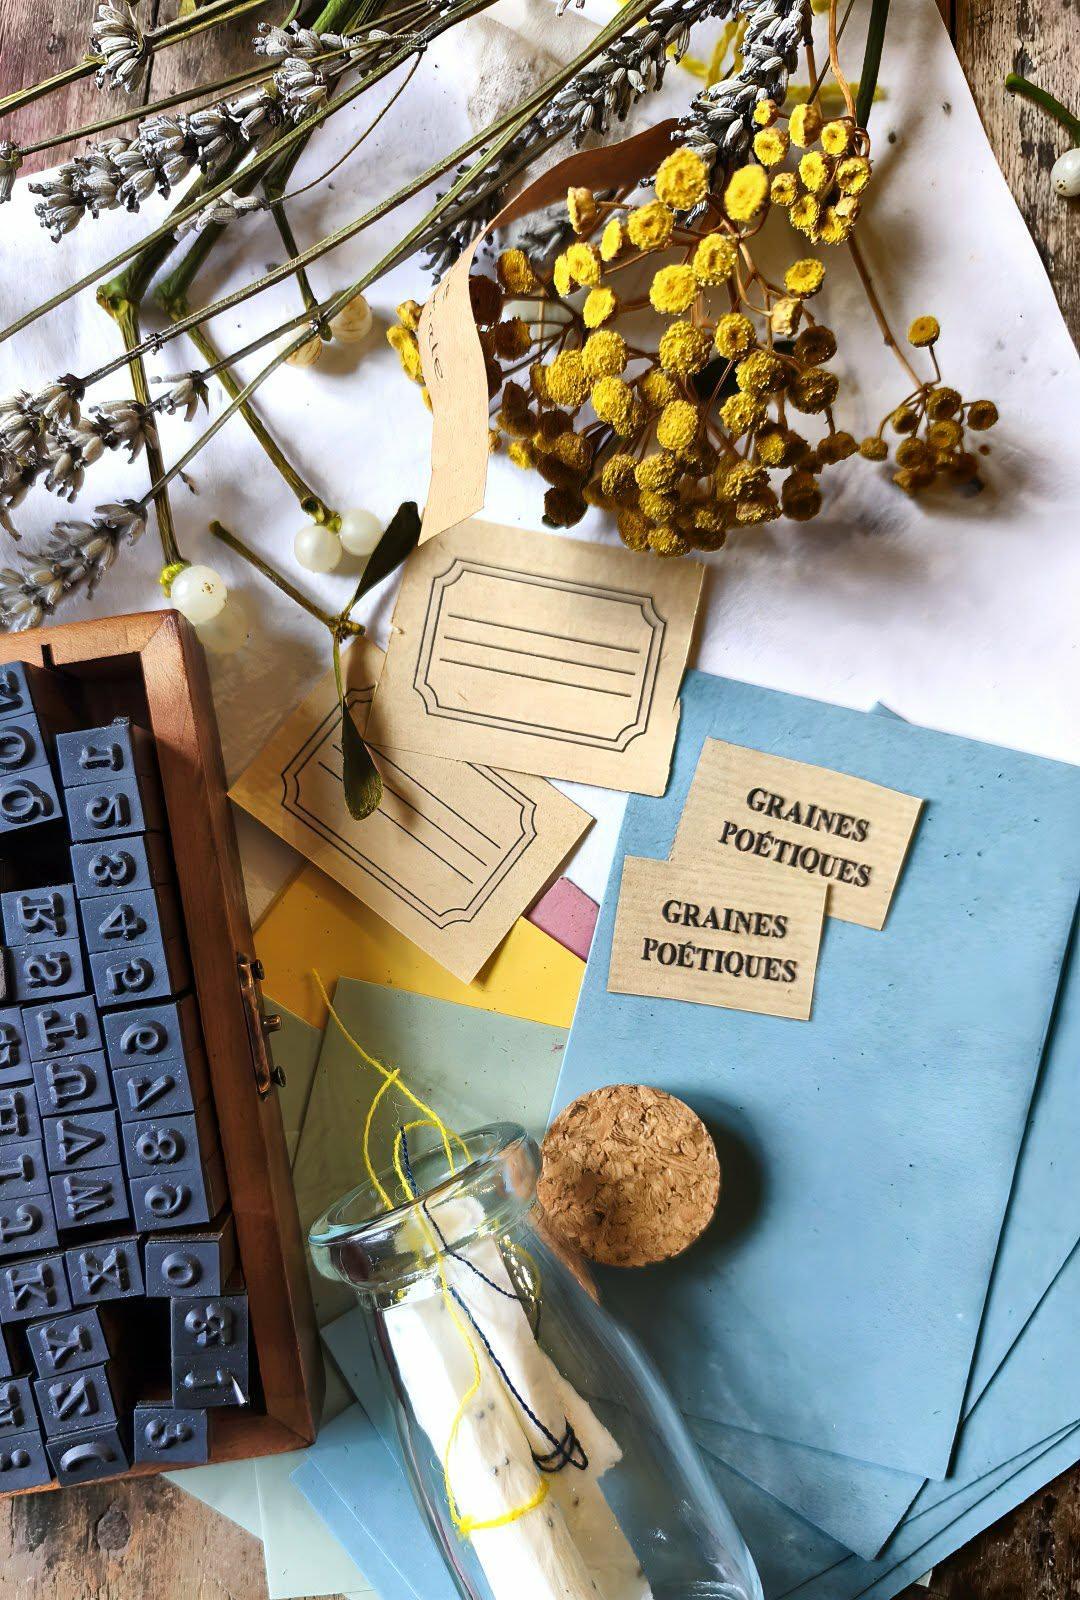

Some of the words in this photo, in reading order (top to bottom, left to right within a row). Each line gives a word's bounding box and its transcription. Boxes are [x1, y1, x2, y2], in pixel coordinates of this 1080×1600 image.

[746, 786, 870, 843] GRAINES
[717, 820, 872, 888] POÉTIQUES
[661, 898, 789, 939] GRAINES
[640, 937, 798, 983] POÉTIQUES
